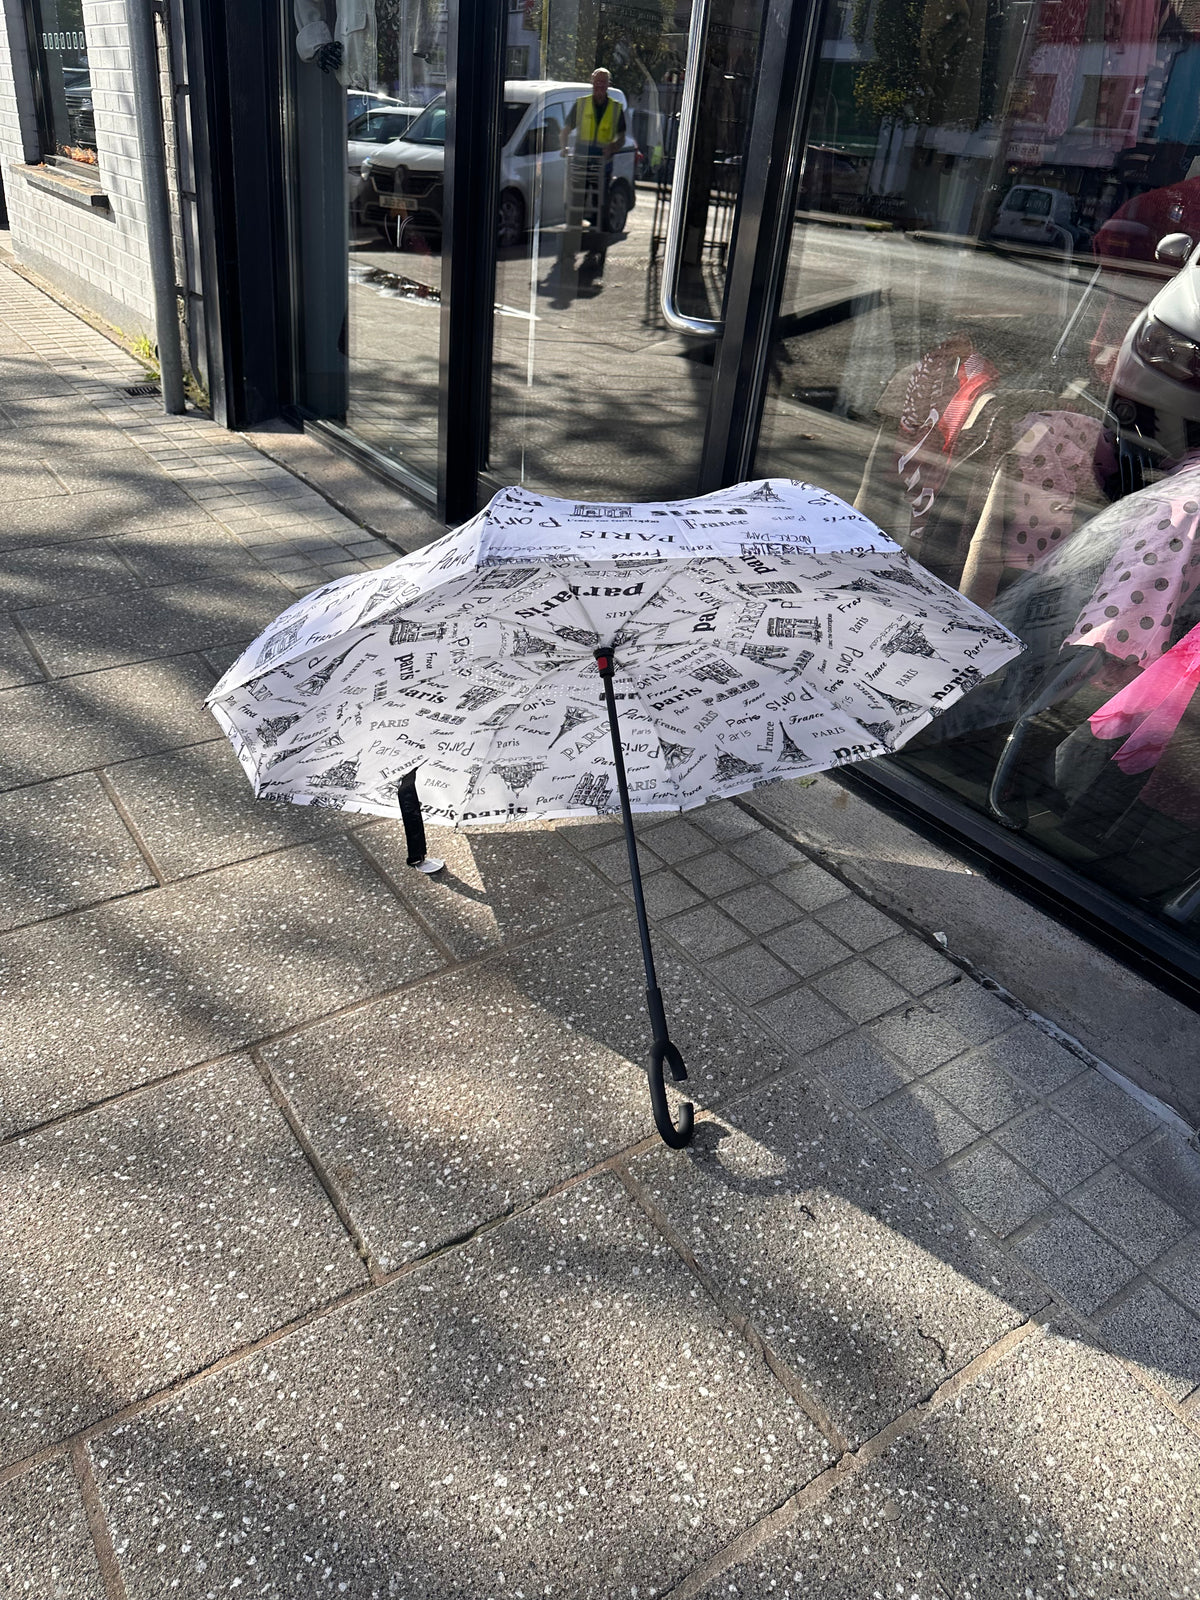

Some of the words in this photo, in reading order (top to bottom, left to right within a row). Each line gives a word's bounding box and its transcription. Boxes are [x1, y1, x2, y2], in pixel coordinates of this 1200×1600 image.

[681, 517, 748, 530] France
[579, 530, 676, 543] PARIS
[394, 652, 420, 682] paris
[864, 661, 888, 683] France
[895, 668, 920, 688] PARIS
[650, 686, 704, 712] paris
[766, 685, 815, 712] Paris
[369, 718, 411, 732] PARIS
[693, 710, 720, 734] PARIS
[725, 712, 762, 729] Paris
[788, 711, 825, 727] France
[515, 724, 552, 737] France
[716, 729, 752, 746] Paris
[757, 721, 775, 753] France
[811, 726, 847, 739] PARIS
[369, 740, 401, 758] Paris
[437, 741, 476, 758] Paris
[496, 738, 521, 750] Paris
[379, 754, 425, 781] France
[616, 778, 658, 793] ARIS
[419, 801, 459, 823] aris
